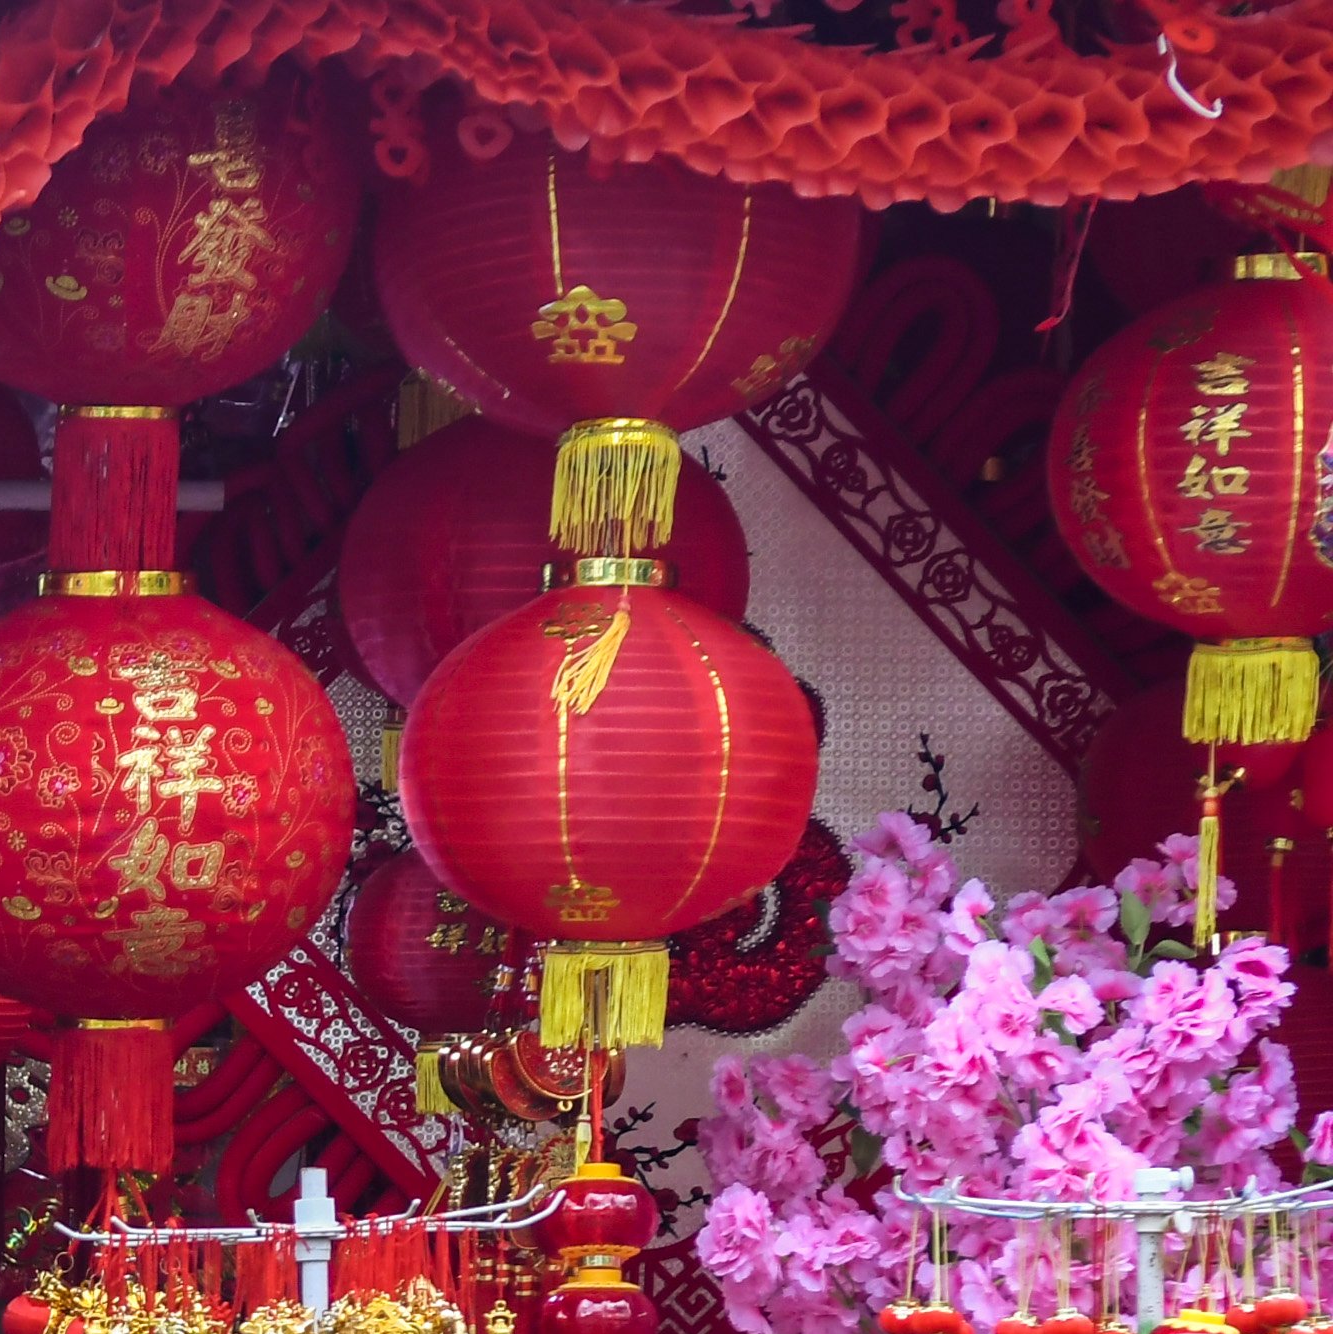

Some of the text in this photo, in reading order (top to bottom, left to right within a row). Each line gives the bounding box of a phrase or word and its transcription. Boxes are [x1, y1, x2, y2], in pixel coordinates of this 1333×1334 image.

[1176, 352, 1256, 555] 吉祥如意
[105, 653, 224, 977] 吉祥如意
